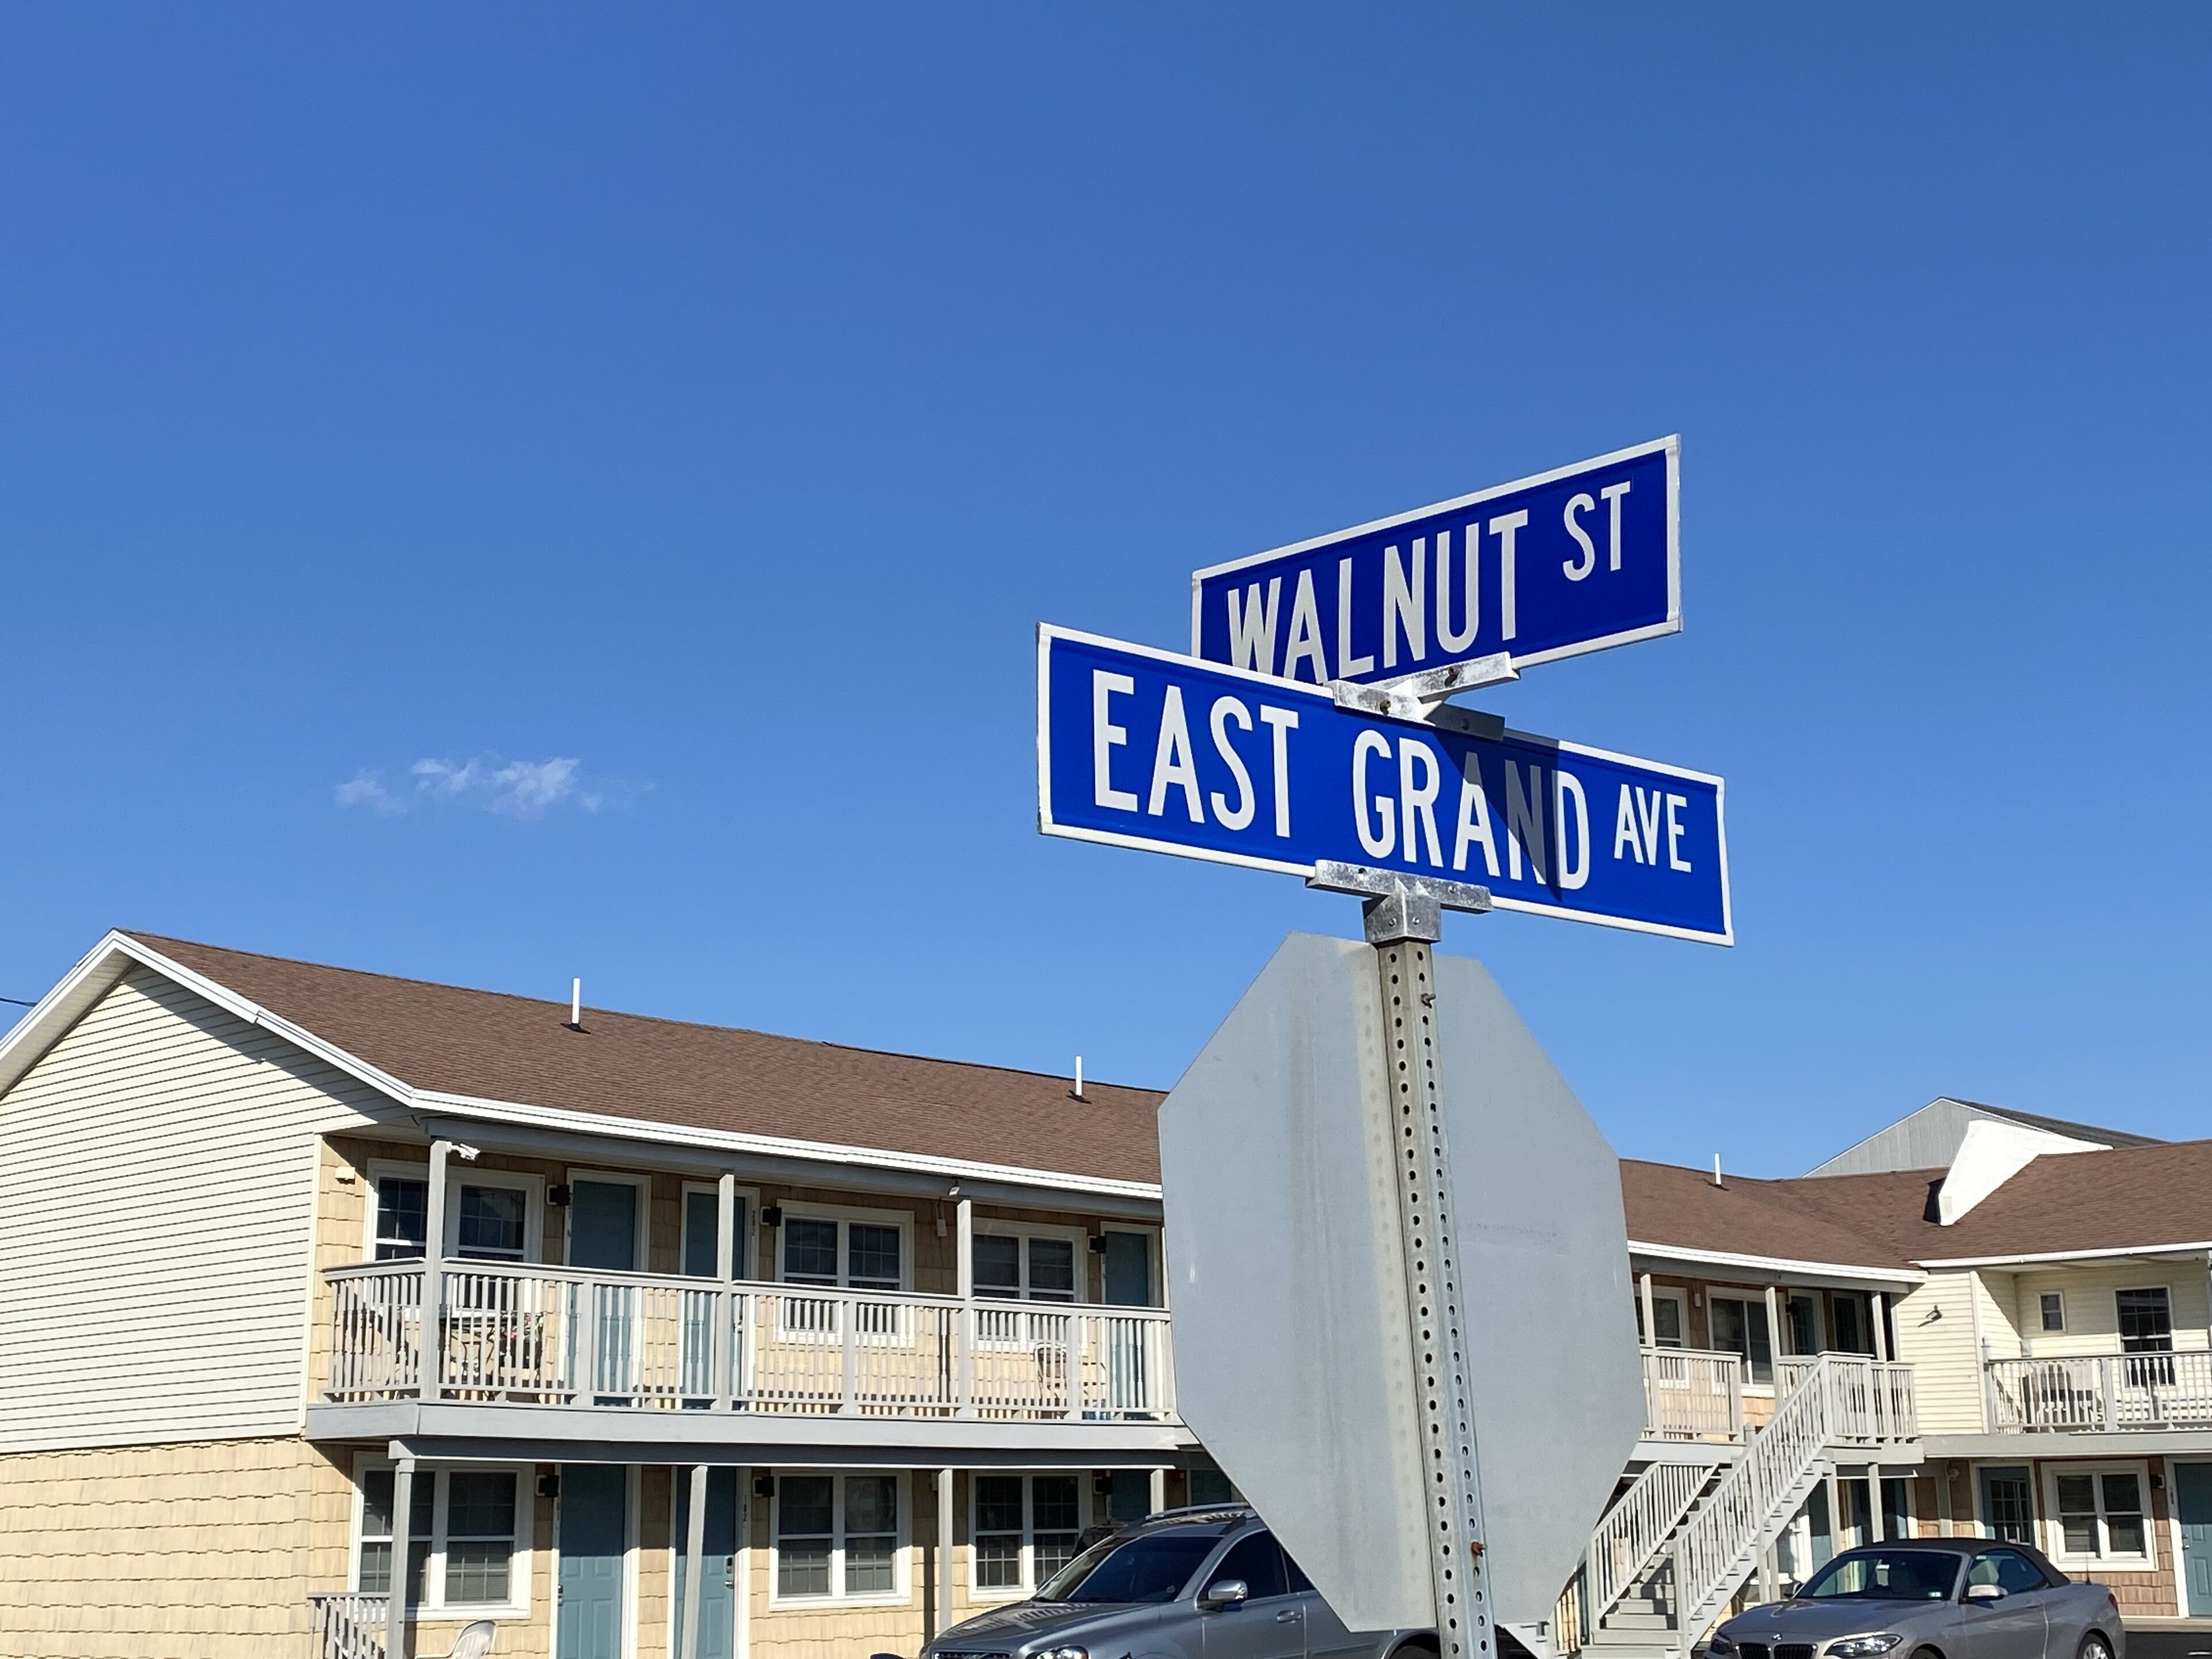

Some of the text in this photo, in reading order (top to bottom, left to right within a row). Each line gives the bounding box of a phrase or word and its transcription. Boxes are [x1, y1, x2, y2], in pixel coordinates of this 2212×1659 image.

[1228, 480, 1631, 684] WALNUT ST
[1092, 669, 1692, 891] EAST GRAND AVE
